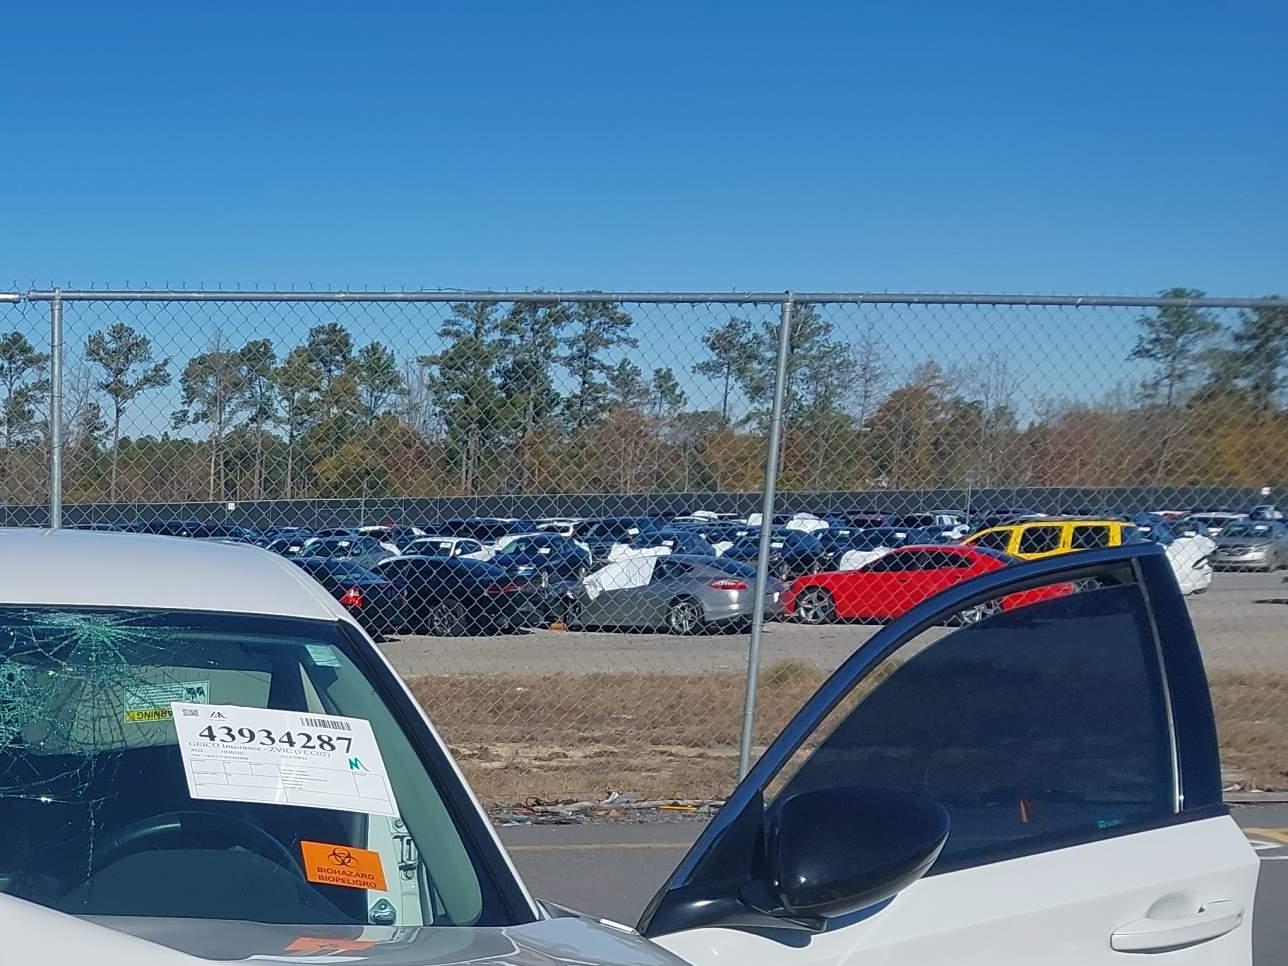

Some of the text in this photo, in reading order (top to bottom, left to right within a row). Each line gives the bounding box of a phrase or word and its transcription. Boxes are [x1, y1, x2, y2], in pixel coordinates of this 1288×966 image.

[136, 708, 173, 720] ARNING
[188, 740, 220, 748] GEICO
[198, 724, 353, 754] 43934287
[317, 866, 375, 880] BIOHAZARD
[318, 874, 377, 889] BIOPELIGRO
